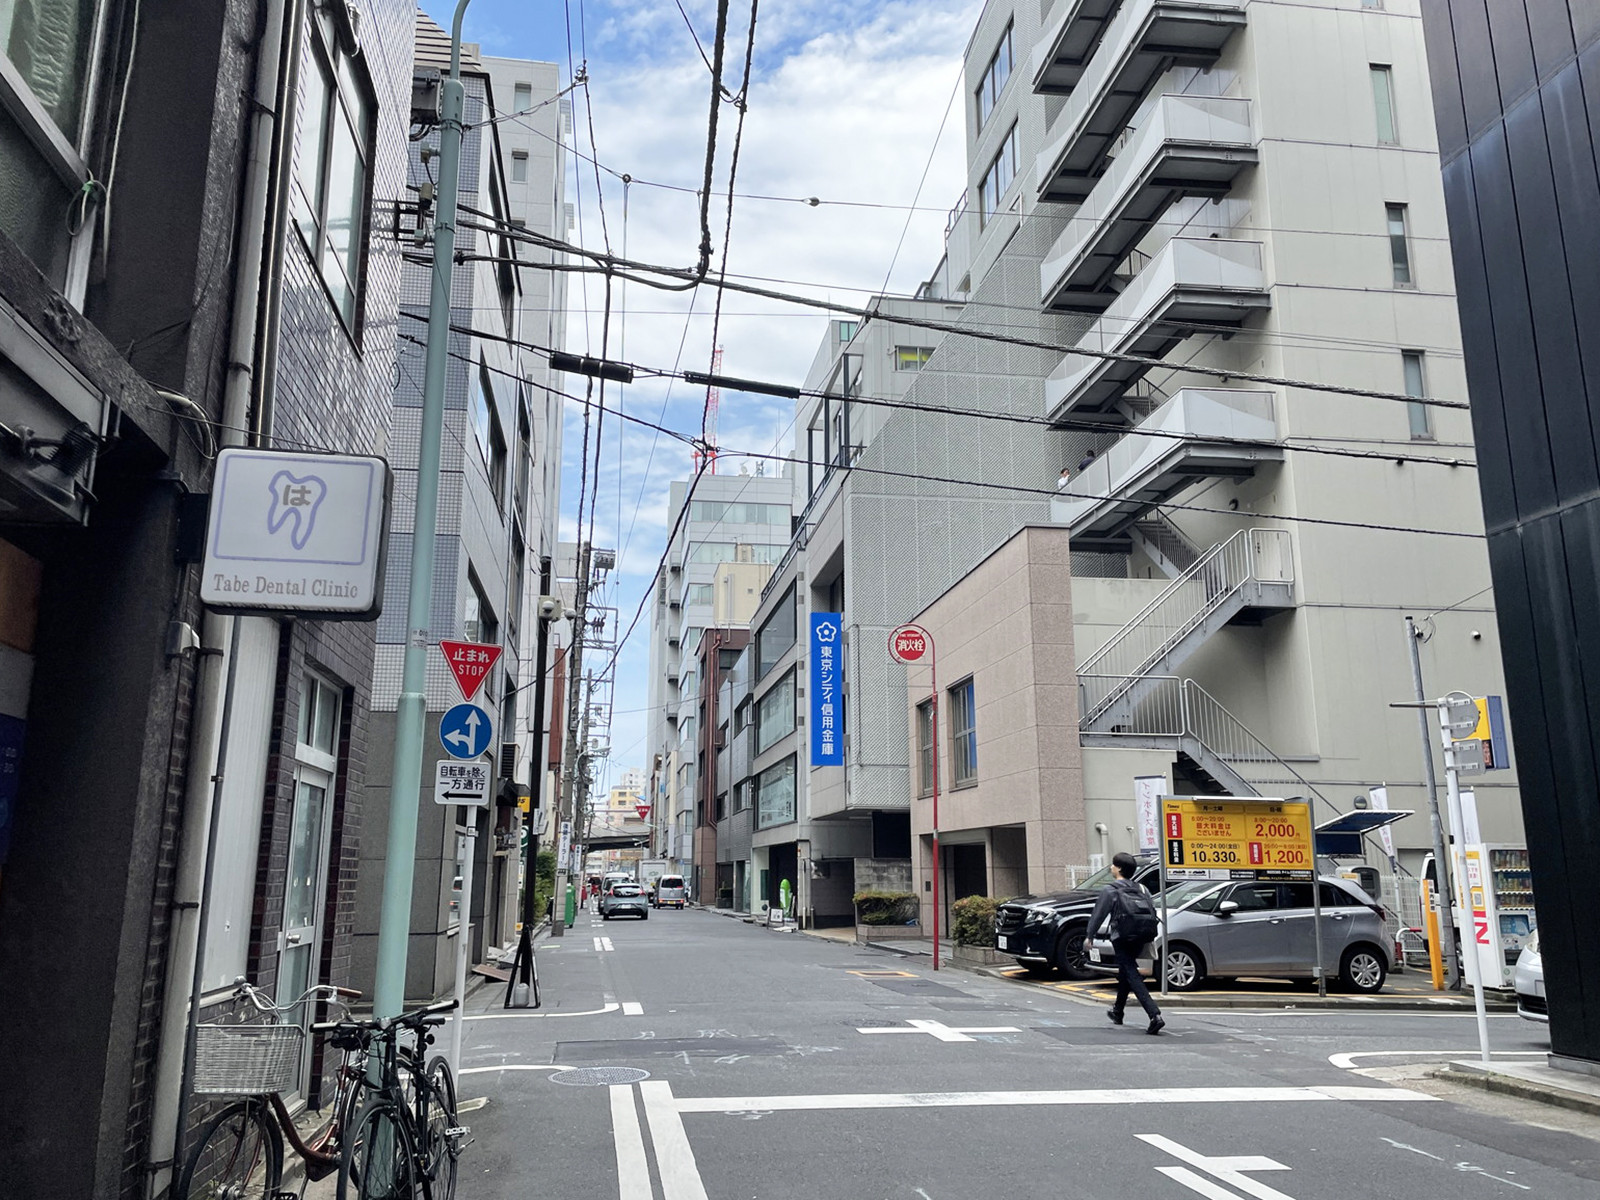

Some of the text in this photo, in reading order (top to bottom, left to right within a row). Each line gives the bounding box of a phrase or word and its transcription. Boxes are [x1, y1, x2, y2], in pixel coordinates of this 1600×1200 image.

[283, 484, 312, 506] は
[213, 574, 358, 598] Tabe Dental Clinic
[898, 639, 924, 651] 消火栓
[452, 648, 490, 663] 止まれ
[458, 664, 484, 676] STOP
[820, 646, 834, 756] 東京シティ信用金庫
[440, 766, 486, 778] 自転車を除く
[440, 778, 486, 791] 一方通行
